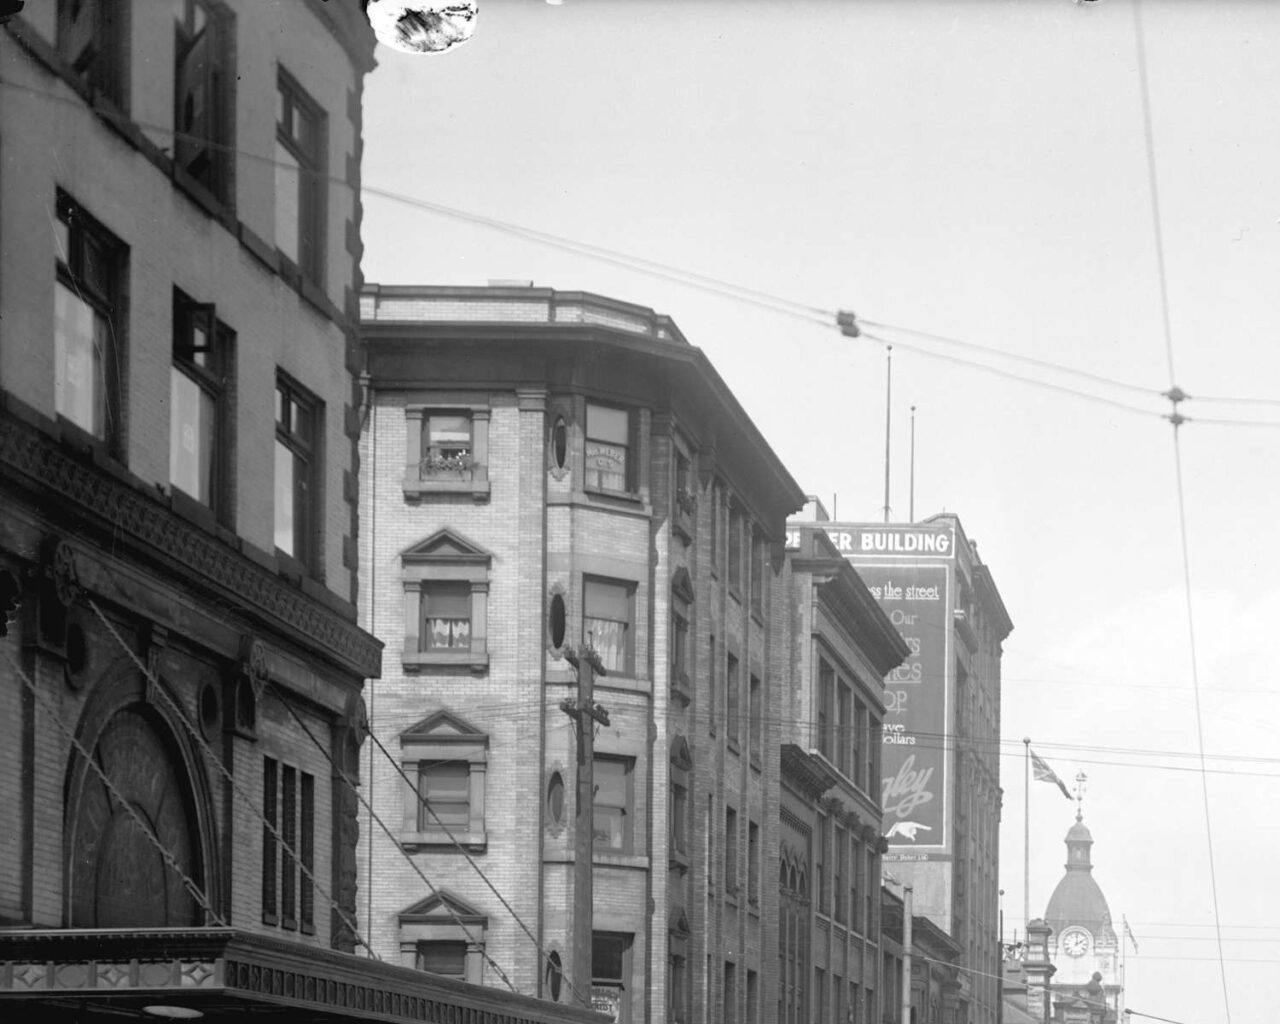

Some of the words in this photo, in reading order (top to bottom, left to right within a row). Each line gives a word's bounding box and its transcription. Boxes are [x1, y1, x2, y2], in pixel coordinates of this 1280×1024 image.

[861, 533, 950, 552] BUILDING
[884, 581, 902, 599] the
[905, 585, 940, 599] street
